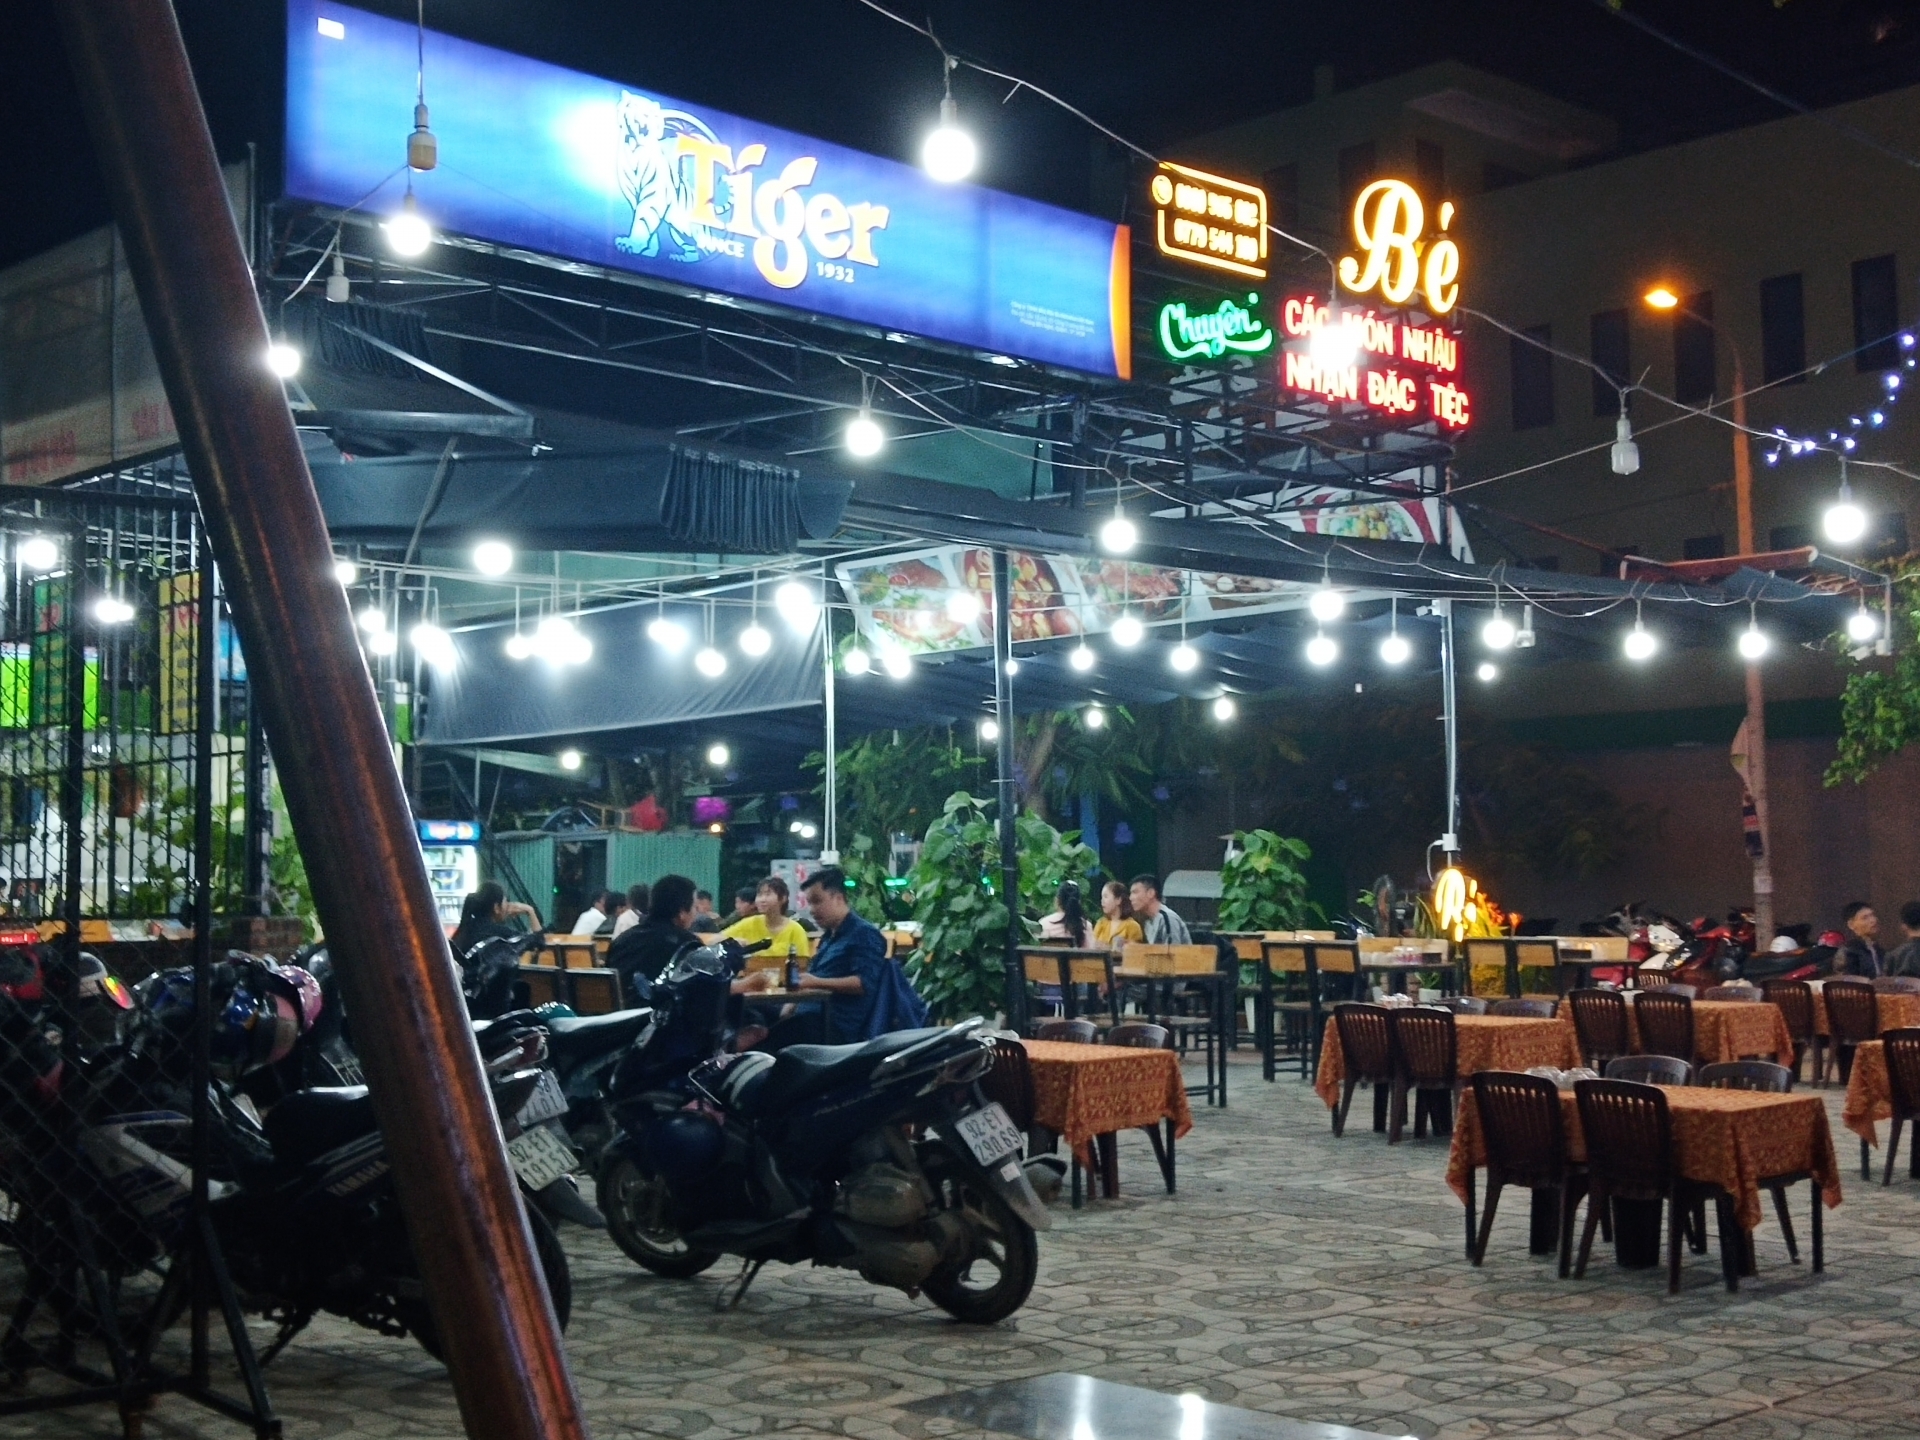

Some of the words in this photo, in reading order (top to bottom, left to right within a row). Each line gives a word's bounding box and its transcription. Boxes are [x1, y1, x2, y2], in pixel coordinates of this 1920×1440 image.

[676, 133, 890, 289] Tiger
[1339, 178, 1460, 314] Bé
[815, 261, 855, 284] 1932
[1402, 325, 1457, 372] NHẬU
